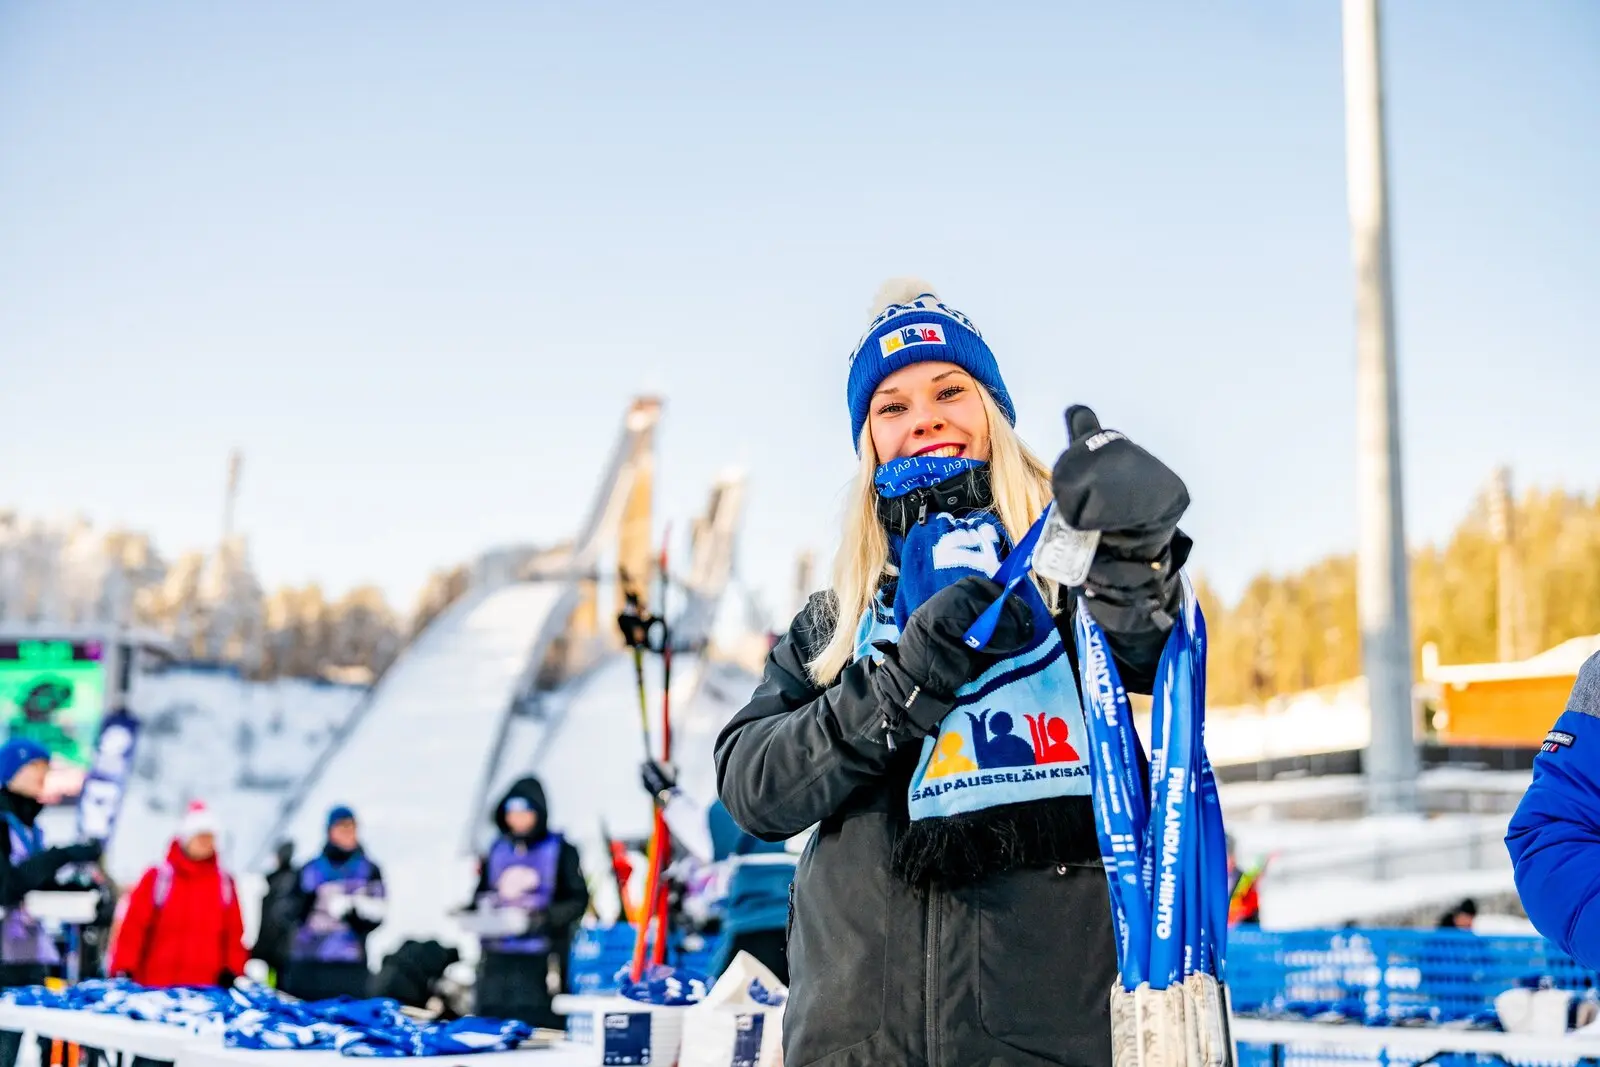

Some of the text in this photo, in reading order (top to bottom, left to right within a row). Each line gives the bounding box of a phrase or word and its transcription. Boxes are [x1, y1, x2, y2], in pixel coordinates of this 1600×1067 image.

[893, 457, 919, 476] Levi
[943, 459, 969, 476] Levi
[911, 765, 1090, 801] SALPAUSSELÄN KISAT
[1156, 767, 1185, 940] FINLANDIA-HIIHTO
